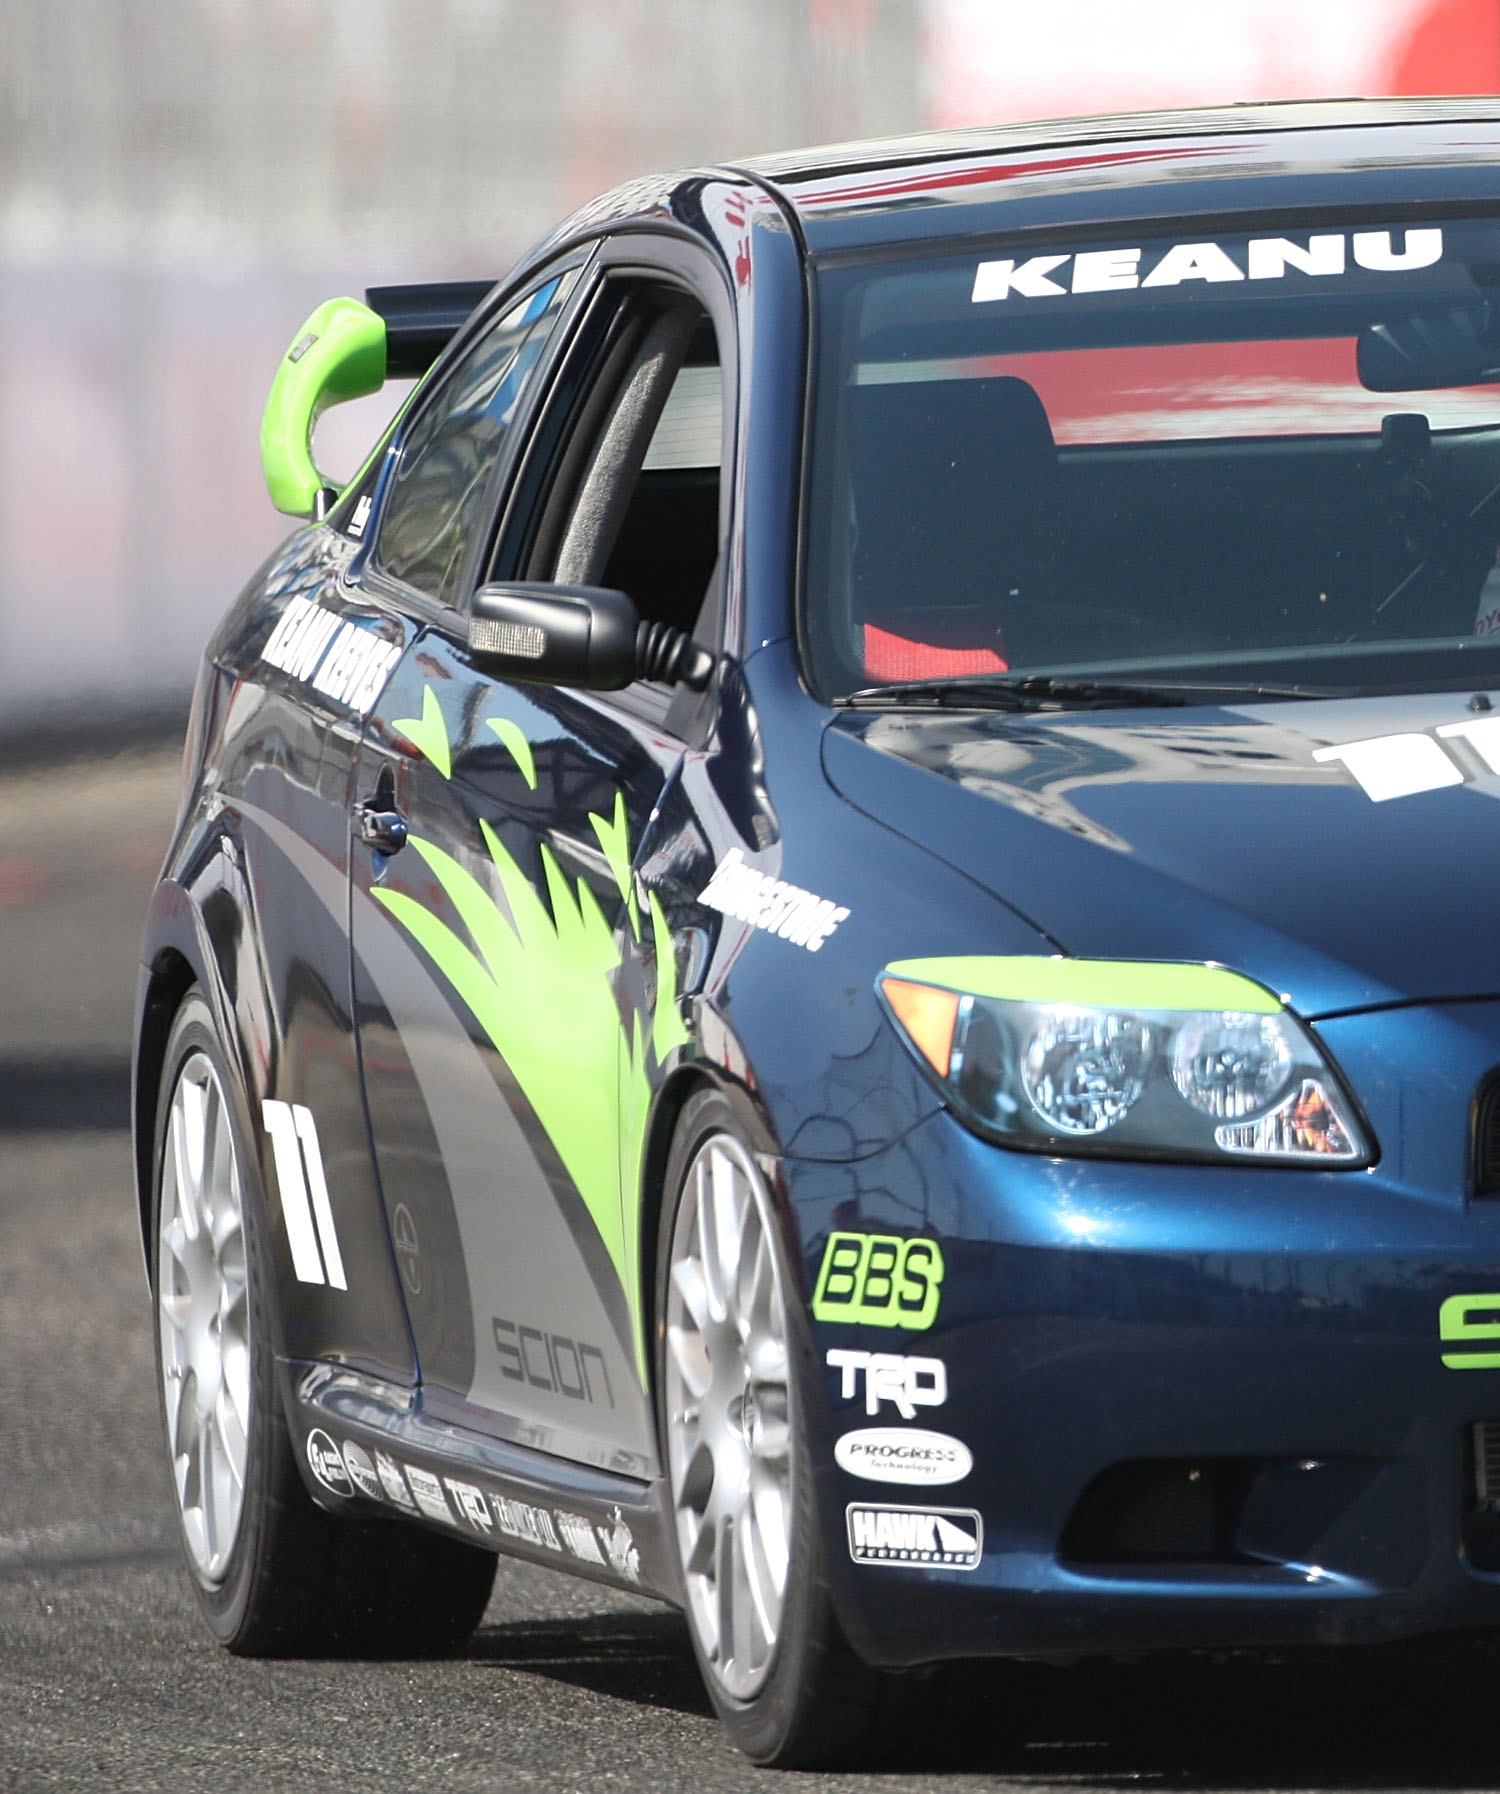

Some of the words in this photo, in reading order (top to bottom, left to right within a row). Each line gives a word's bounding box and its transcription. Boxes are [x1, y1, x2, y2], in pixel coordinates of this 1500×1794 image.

[972, 229, 1442, 303] KEANU
[261, 595, 342, 682] KEANU
[312, 622, 403, 714] REEVES
[262, 1099, 348, 1291] 11
[813, 1232, 943, 1328] BBS
[492, 1316, 615, 1409] SCION
[826, 1349, 947, 1420] TRD
[849, 1443, 958, 1462] PROGRESS
[852, 1509, 939, 1552] HAWK
